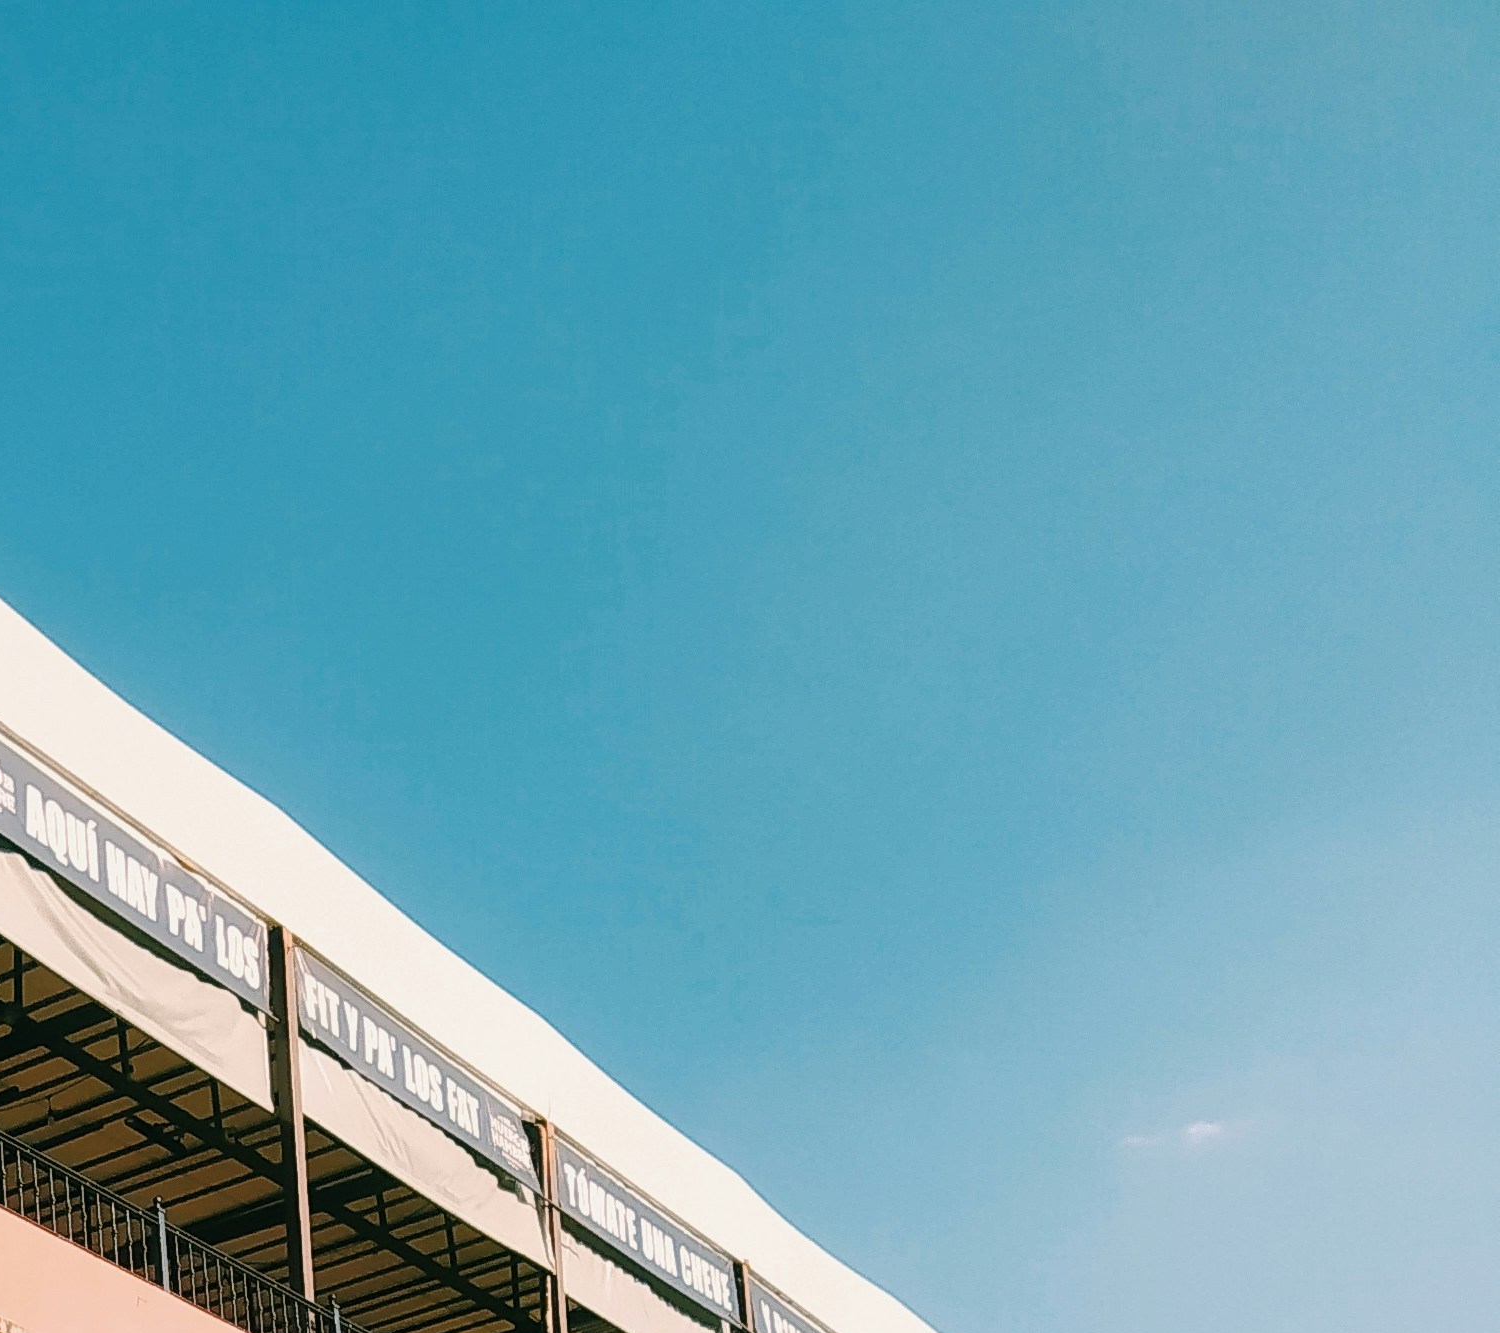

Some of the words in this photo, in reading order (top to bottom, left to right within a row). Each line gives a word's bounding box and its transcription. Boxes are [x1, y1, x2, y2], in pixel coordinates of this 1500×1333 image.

[25, 783, 100, 883] AQUÍ
[105, 839, 159, 923] HAY
[165, 883, 207, 953] PA'
[214, 913, 261, 990] LOS
[304, 972, 340, 1038] FIT
[343, 1000, 359, 1052] Y
[363, 1015, 397, 1080] PA'
[402, 1044, 444, 1112] LOS
[446, 1076, 481, 1140] FAT
[563, 1162, 638, 1251] TÓMATE
[640, 1217, 678, 1279] UNA
[679, 1245, 733, 1312] CHEVE
